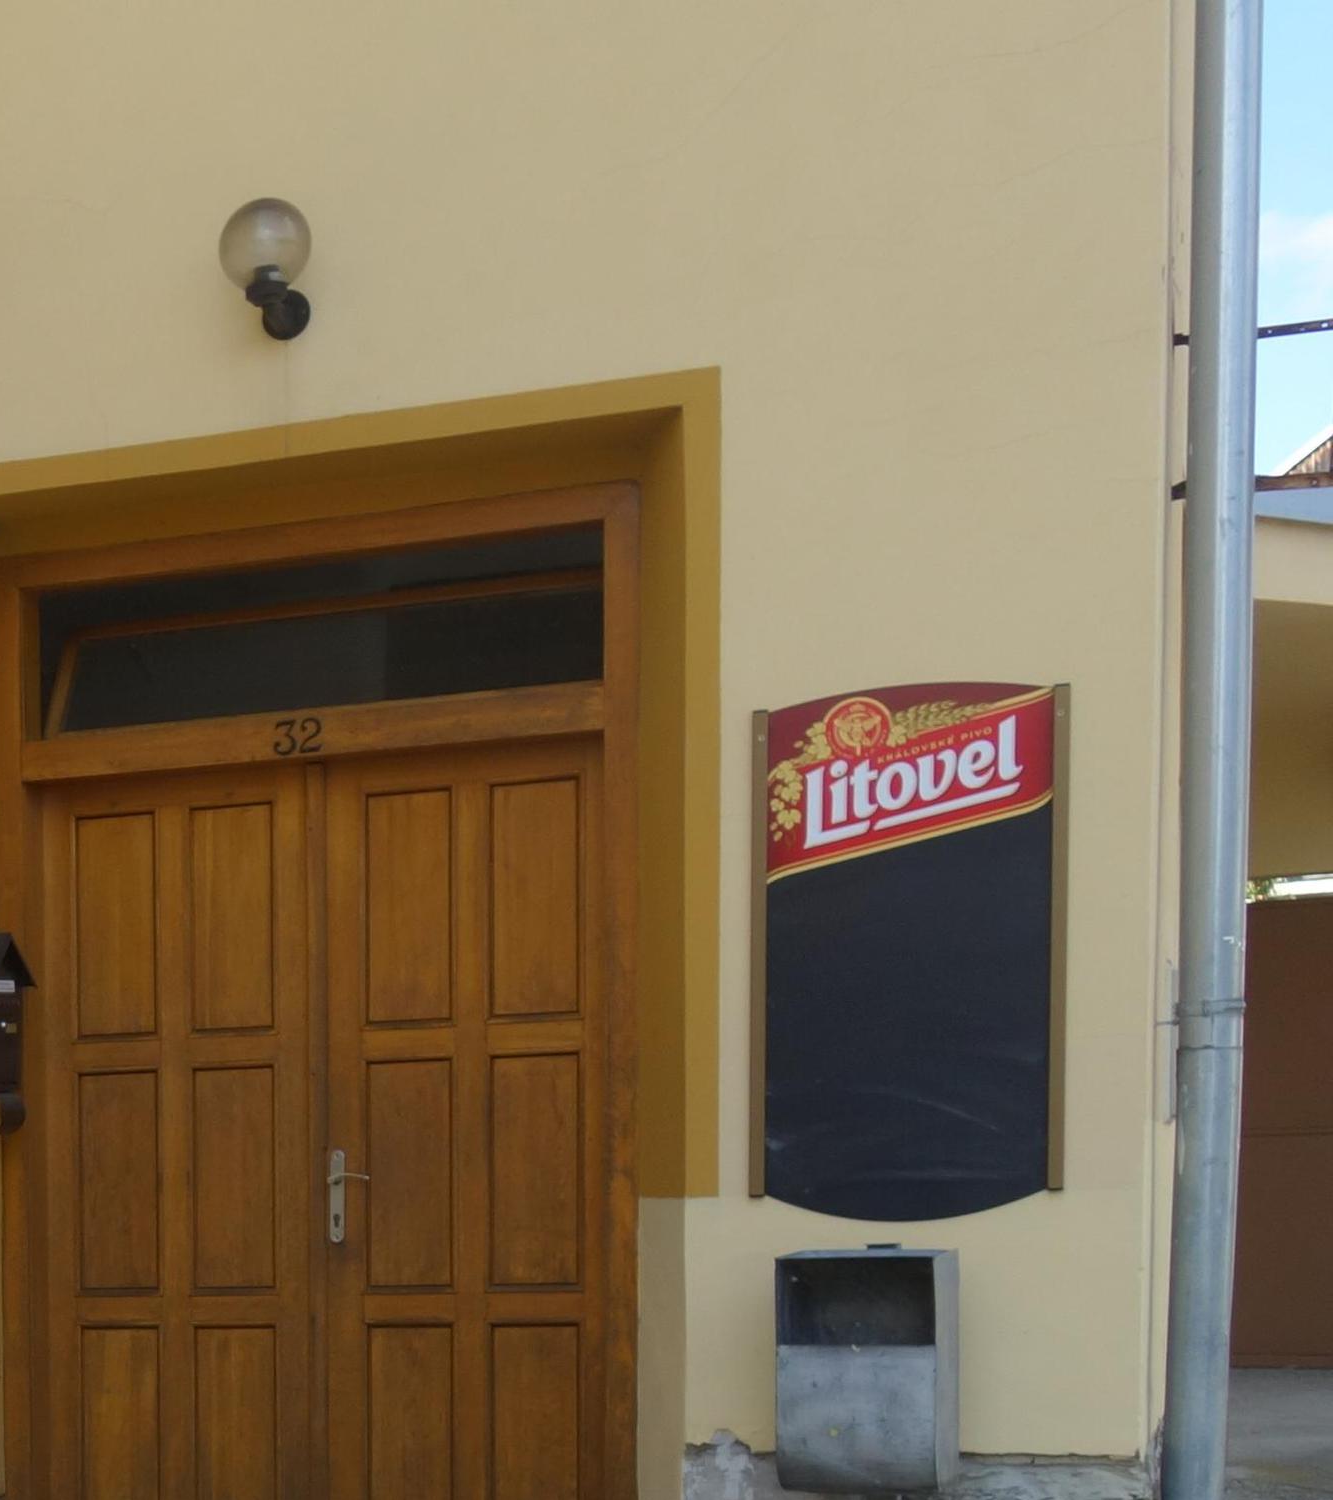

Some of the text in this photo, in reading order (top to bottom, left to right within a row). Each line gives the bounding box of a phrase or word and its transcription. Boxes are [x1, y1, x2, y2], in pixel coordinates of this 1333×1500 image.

[273, 717, 322, 757] 32
[960, 725, 993, 741] PIVO
[804, 715, 1024, 849] Litovel
